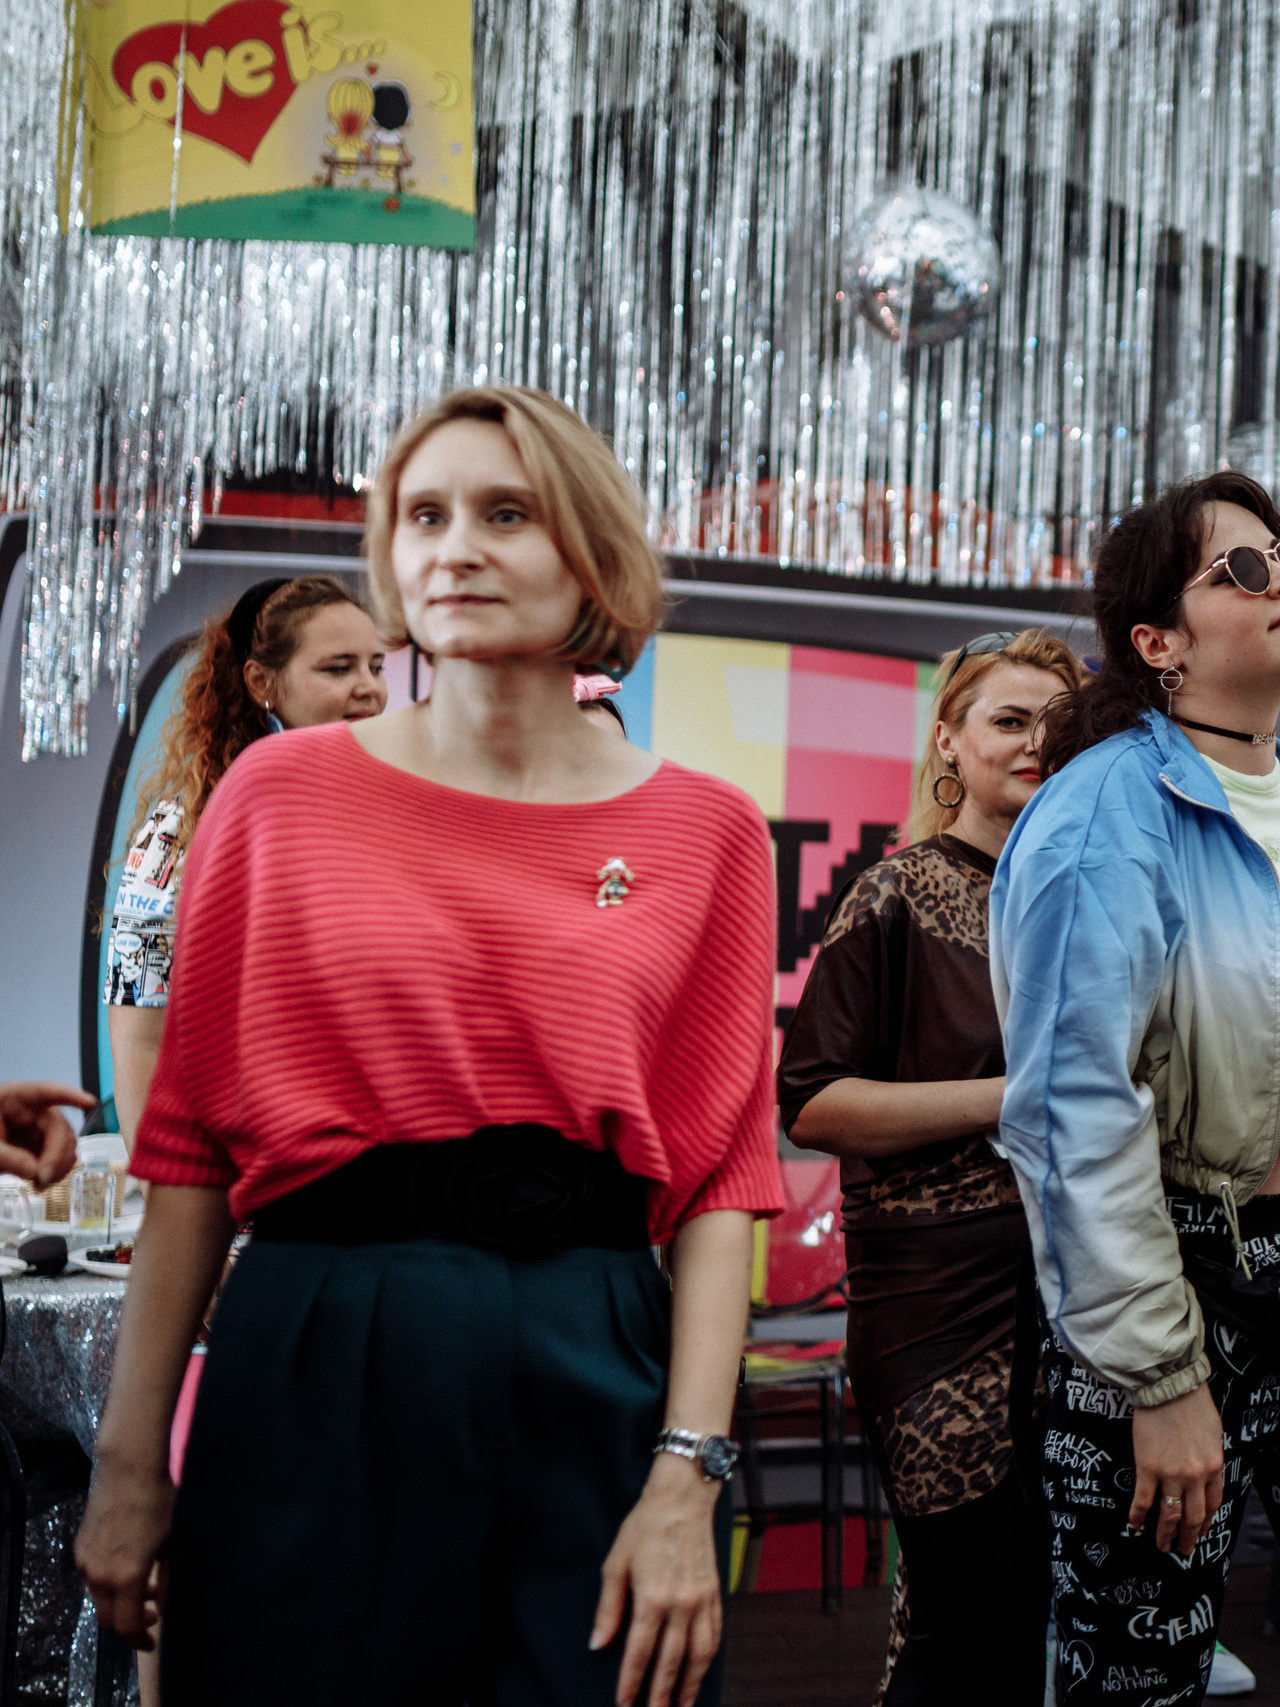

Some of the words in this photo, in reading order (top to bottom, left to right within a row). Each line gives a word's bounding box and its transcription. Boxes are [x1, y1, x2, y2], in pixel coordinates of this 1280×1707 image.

[129, 894, 161, 912] THE
[1169, 1529, 1232, 1571] WILD
[1158, 1594, 1214, 1646] YEAH
[1102, 1672, 1168, 1692] NOTHING
